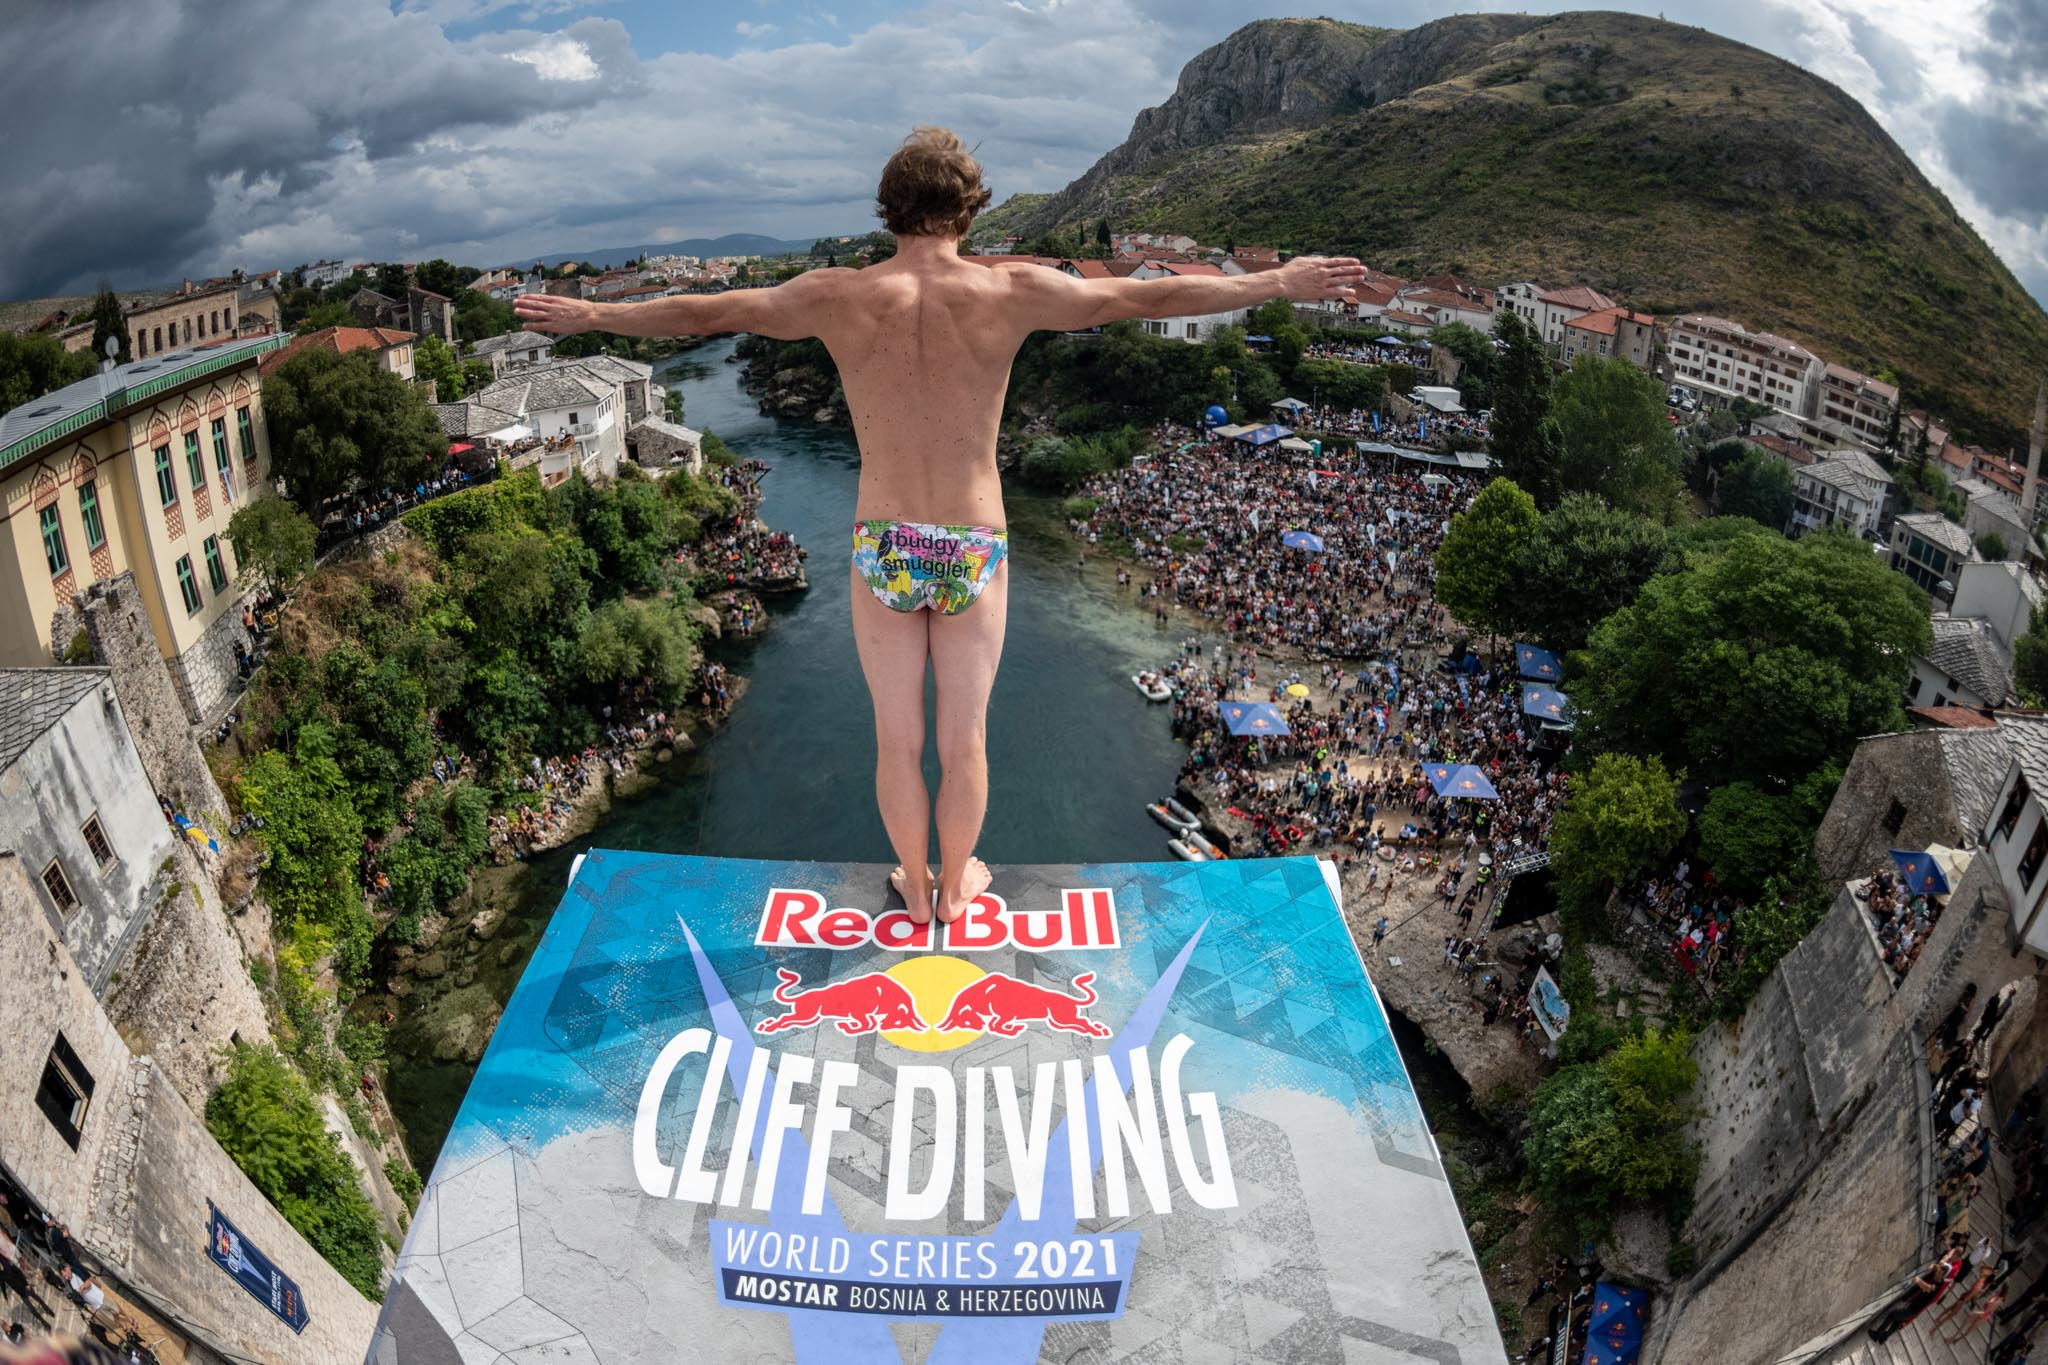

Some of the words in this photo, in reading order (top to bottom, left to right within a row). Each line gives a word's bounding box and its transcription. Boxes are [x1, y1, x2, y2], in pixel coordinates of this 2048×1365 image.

[896, 530, 960, 556] budgy
[882, 556, 972, 579] smuggler
[759, 889, 932, 949] Red
[945, 890, 1116, 949] Bull
[632, 1028, 860, 1215] CLIFF
[885, 1033, 1239, 1221] DIVING
[726, 1227, 850, 1275] WORLD
[869, 1240, 998, 1279] SERIES
[1014, 1238, 1118, 1279] 2021
[736, 1275, 838, 1306] MOSTAR
[850, 1287, 926, 1311] BOSNIA
[936, 1288, 950, 1311] &
[960, 1287, 1105, 1313] HERZEGOVINA
